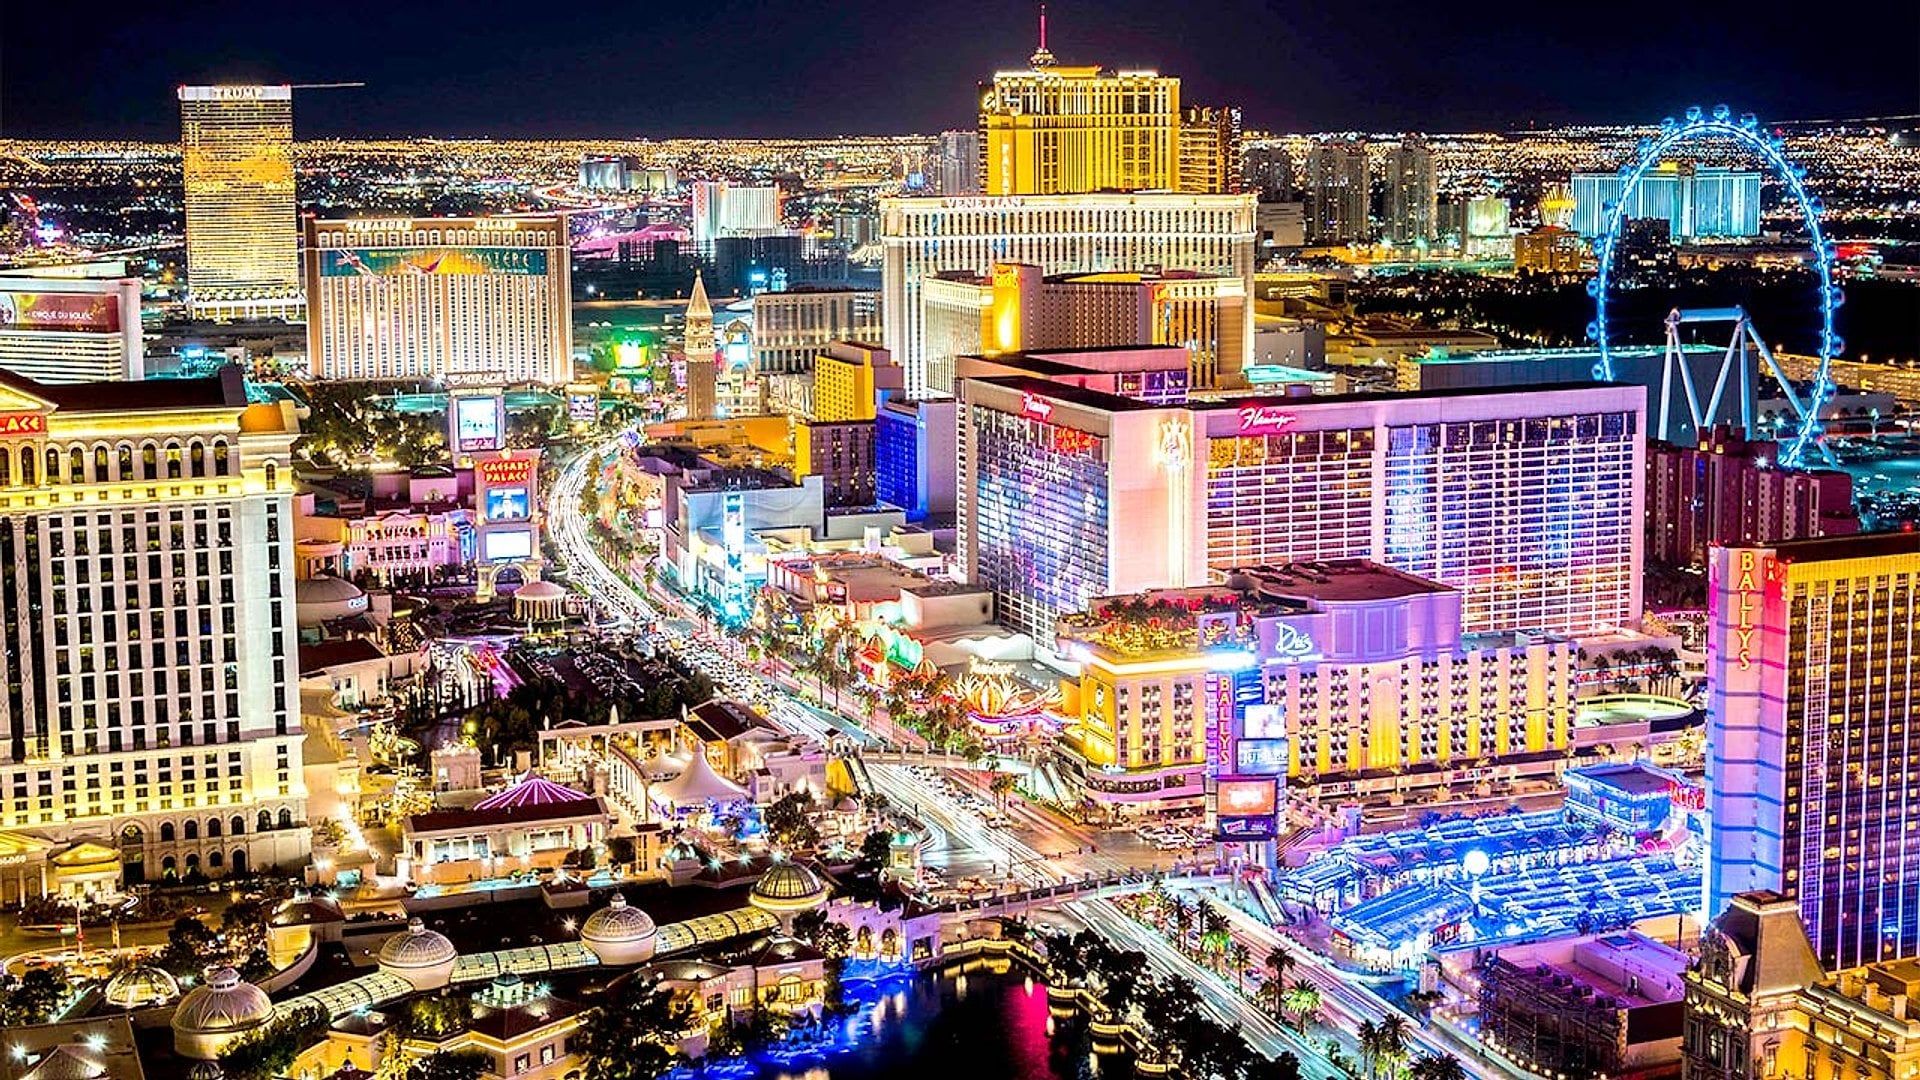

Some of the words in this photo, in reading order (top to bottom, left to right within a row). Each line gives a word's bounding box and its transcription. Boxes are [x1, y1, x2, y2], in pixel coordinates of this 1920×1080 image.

[213, 87, 263, 99] TRUMP
[946, 197, 1020, 208] VENETIAN
[1239, 408, 1297, 430] Flamingo
[482, 461, 530, 472] CAESARS
[485, 471, 527, 482] PALACE
